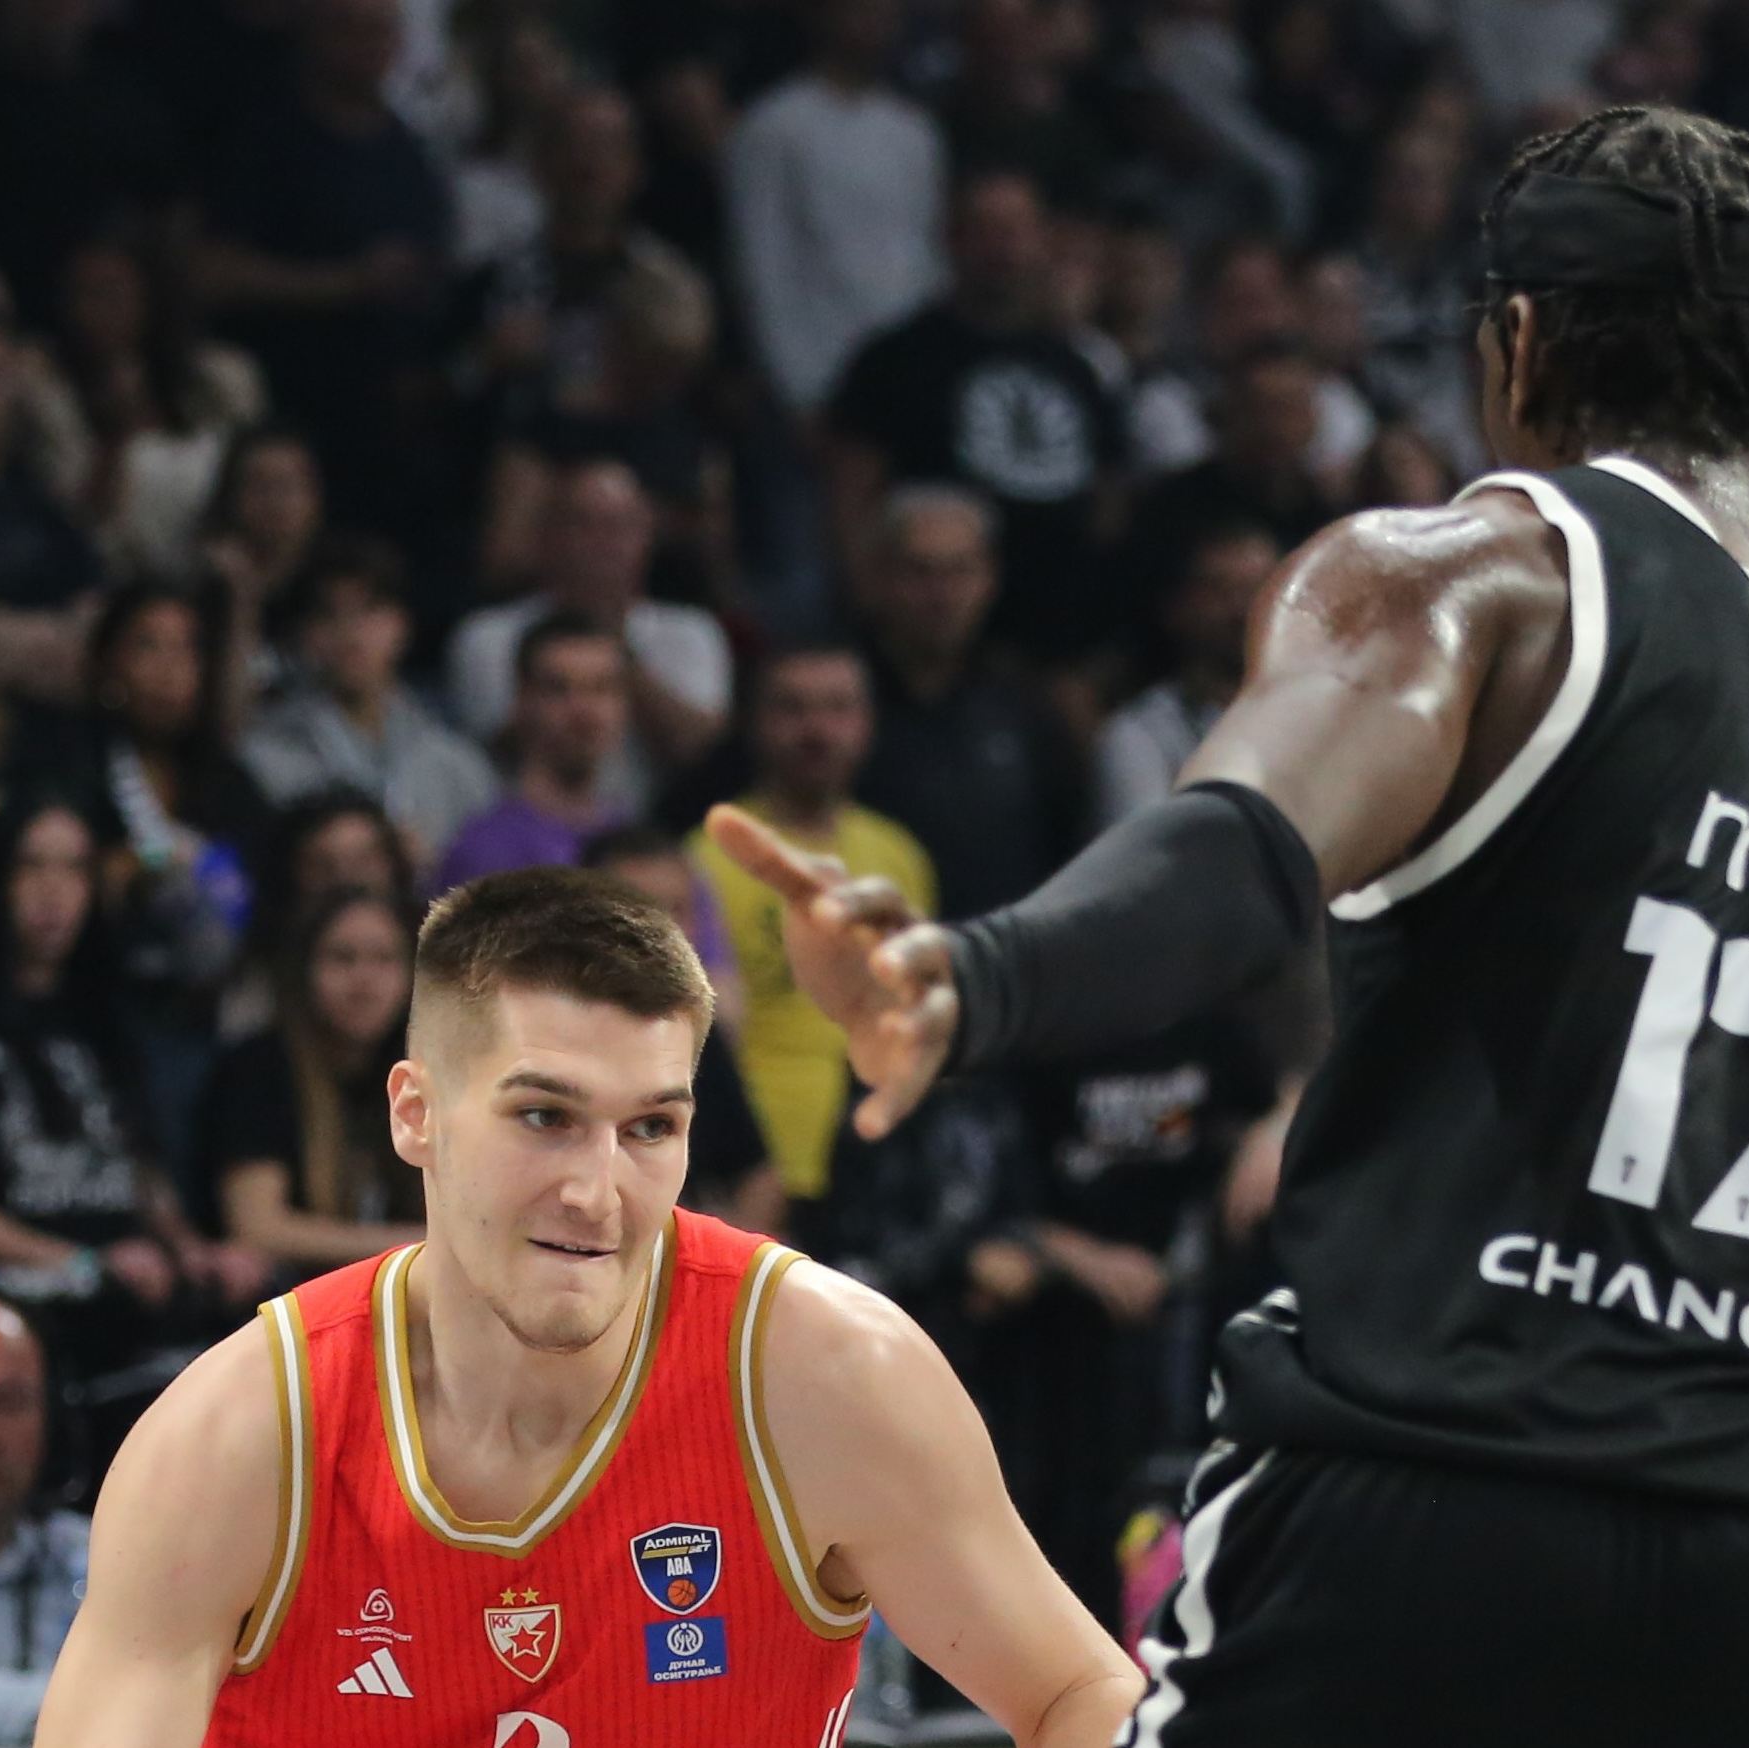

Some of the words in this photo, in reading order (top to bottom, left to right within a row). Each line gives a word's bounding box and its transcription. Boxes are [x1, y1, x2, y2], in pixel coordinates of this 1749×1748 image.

[644, 1532, 712, 1551] ADMIRAL
[666, 1556, 693, 1577] ABA
[491, 1615, 514, 1629] KK
